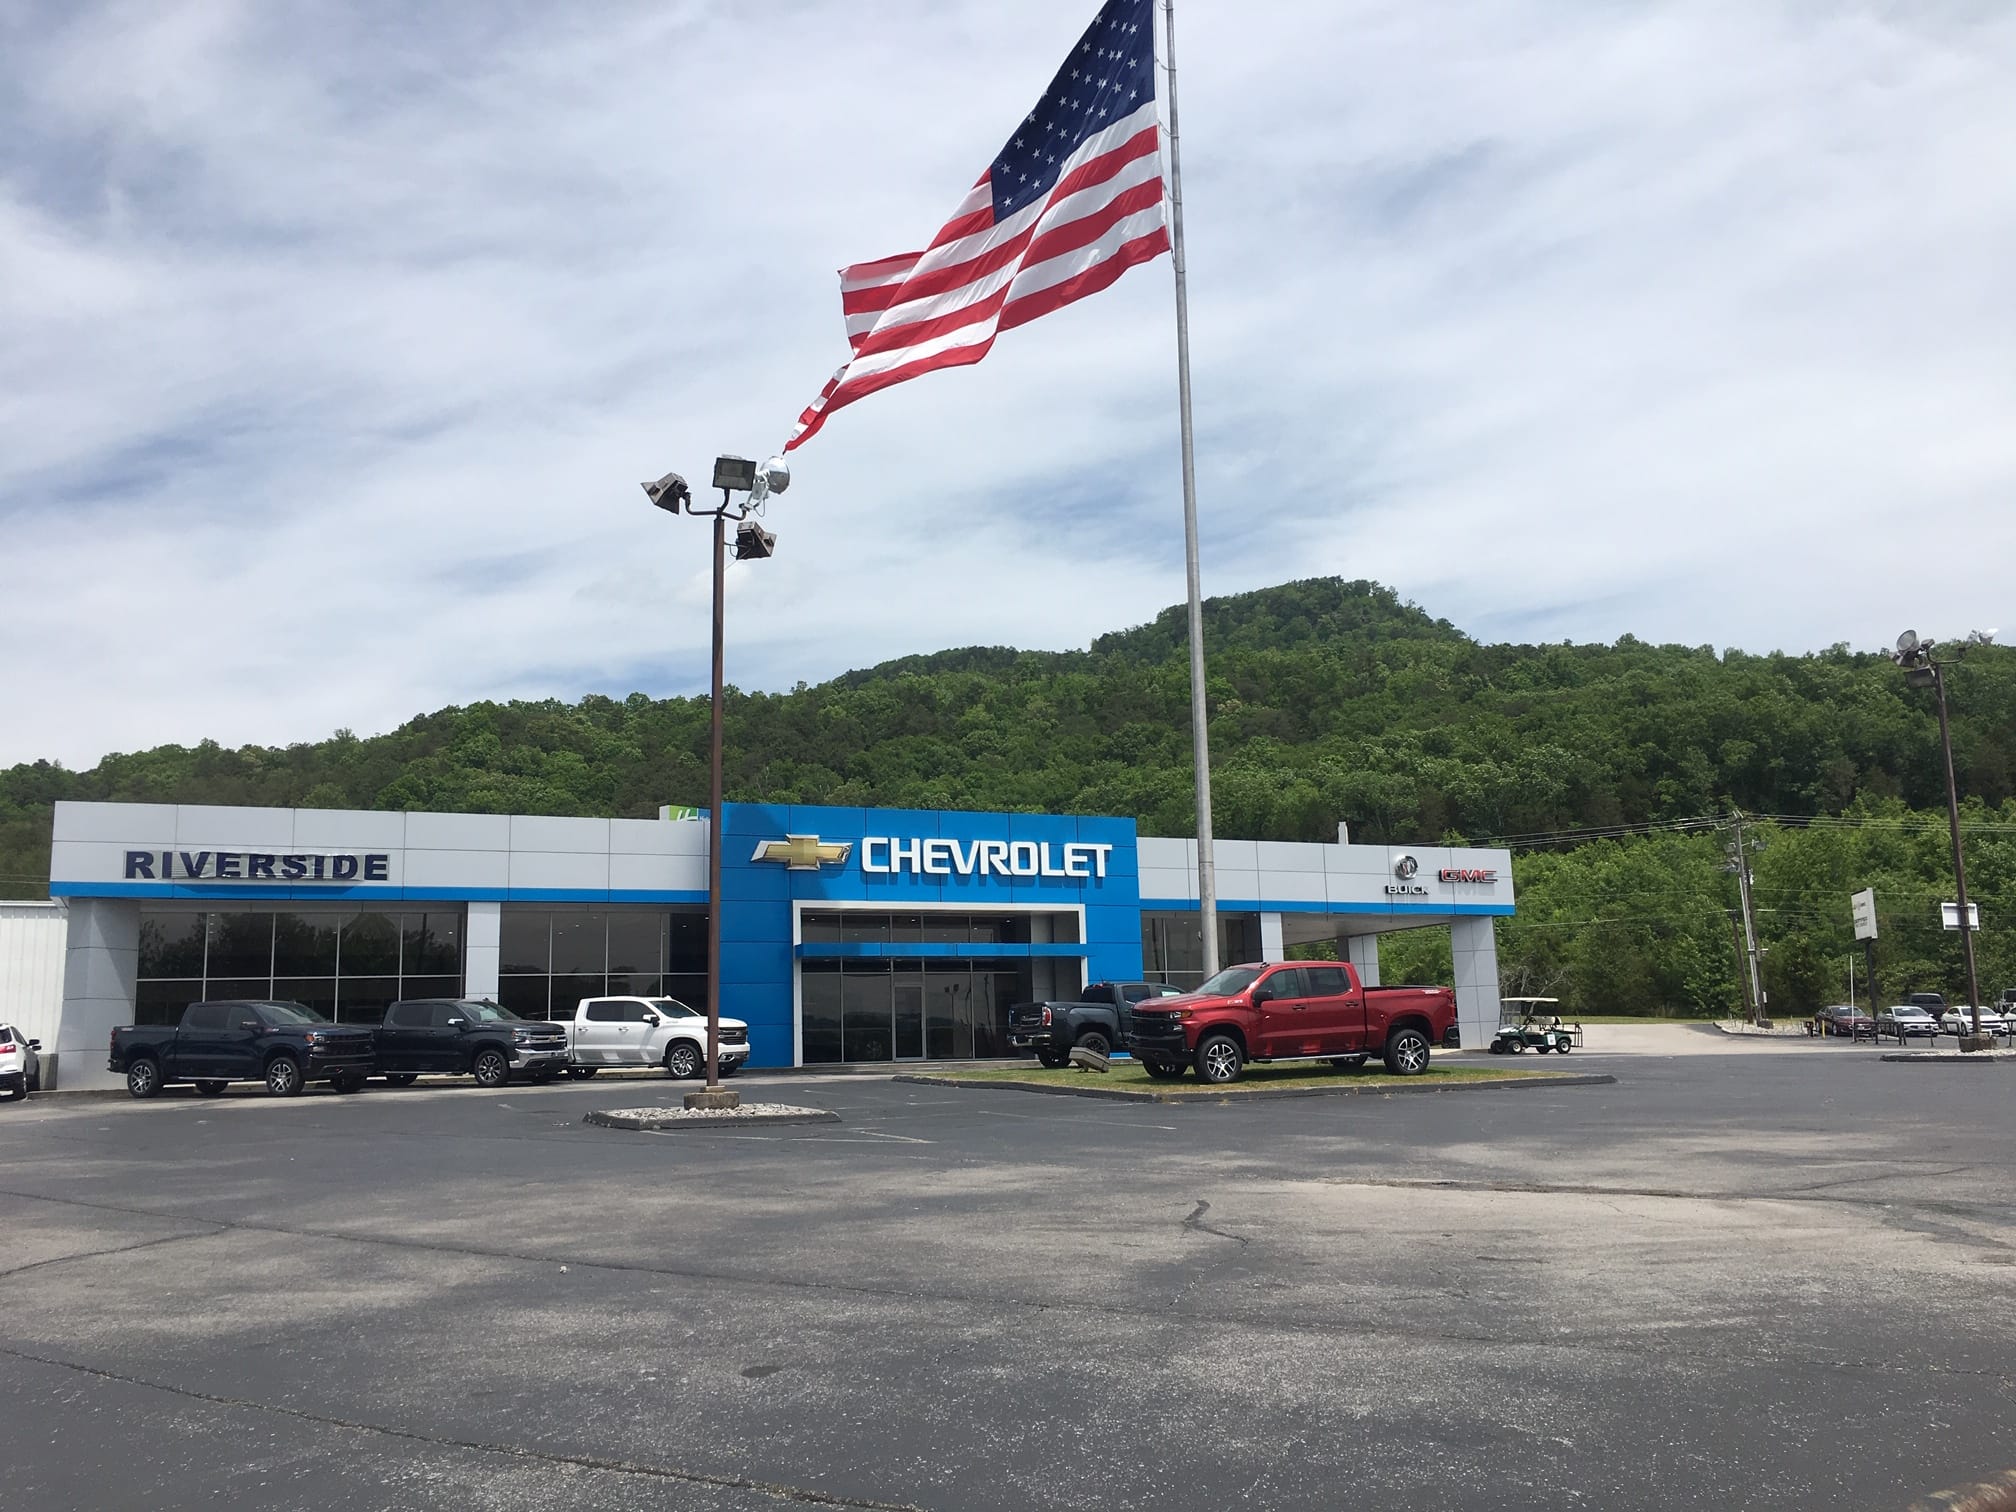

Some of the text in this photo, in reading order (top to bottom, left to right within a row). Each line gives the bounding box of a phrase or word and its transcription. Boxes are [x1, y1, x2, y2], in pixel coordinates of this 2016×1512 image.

[125, 851, 388, 881] RIVERSIDE
[861, 837, 1112, 878] CHEVROLET
[1438, 868, 1498, 883] GMC
[1385, 885, 1428, 895] BUICK
